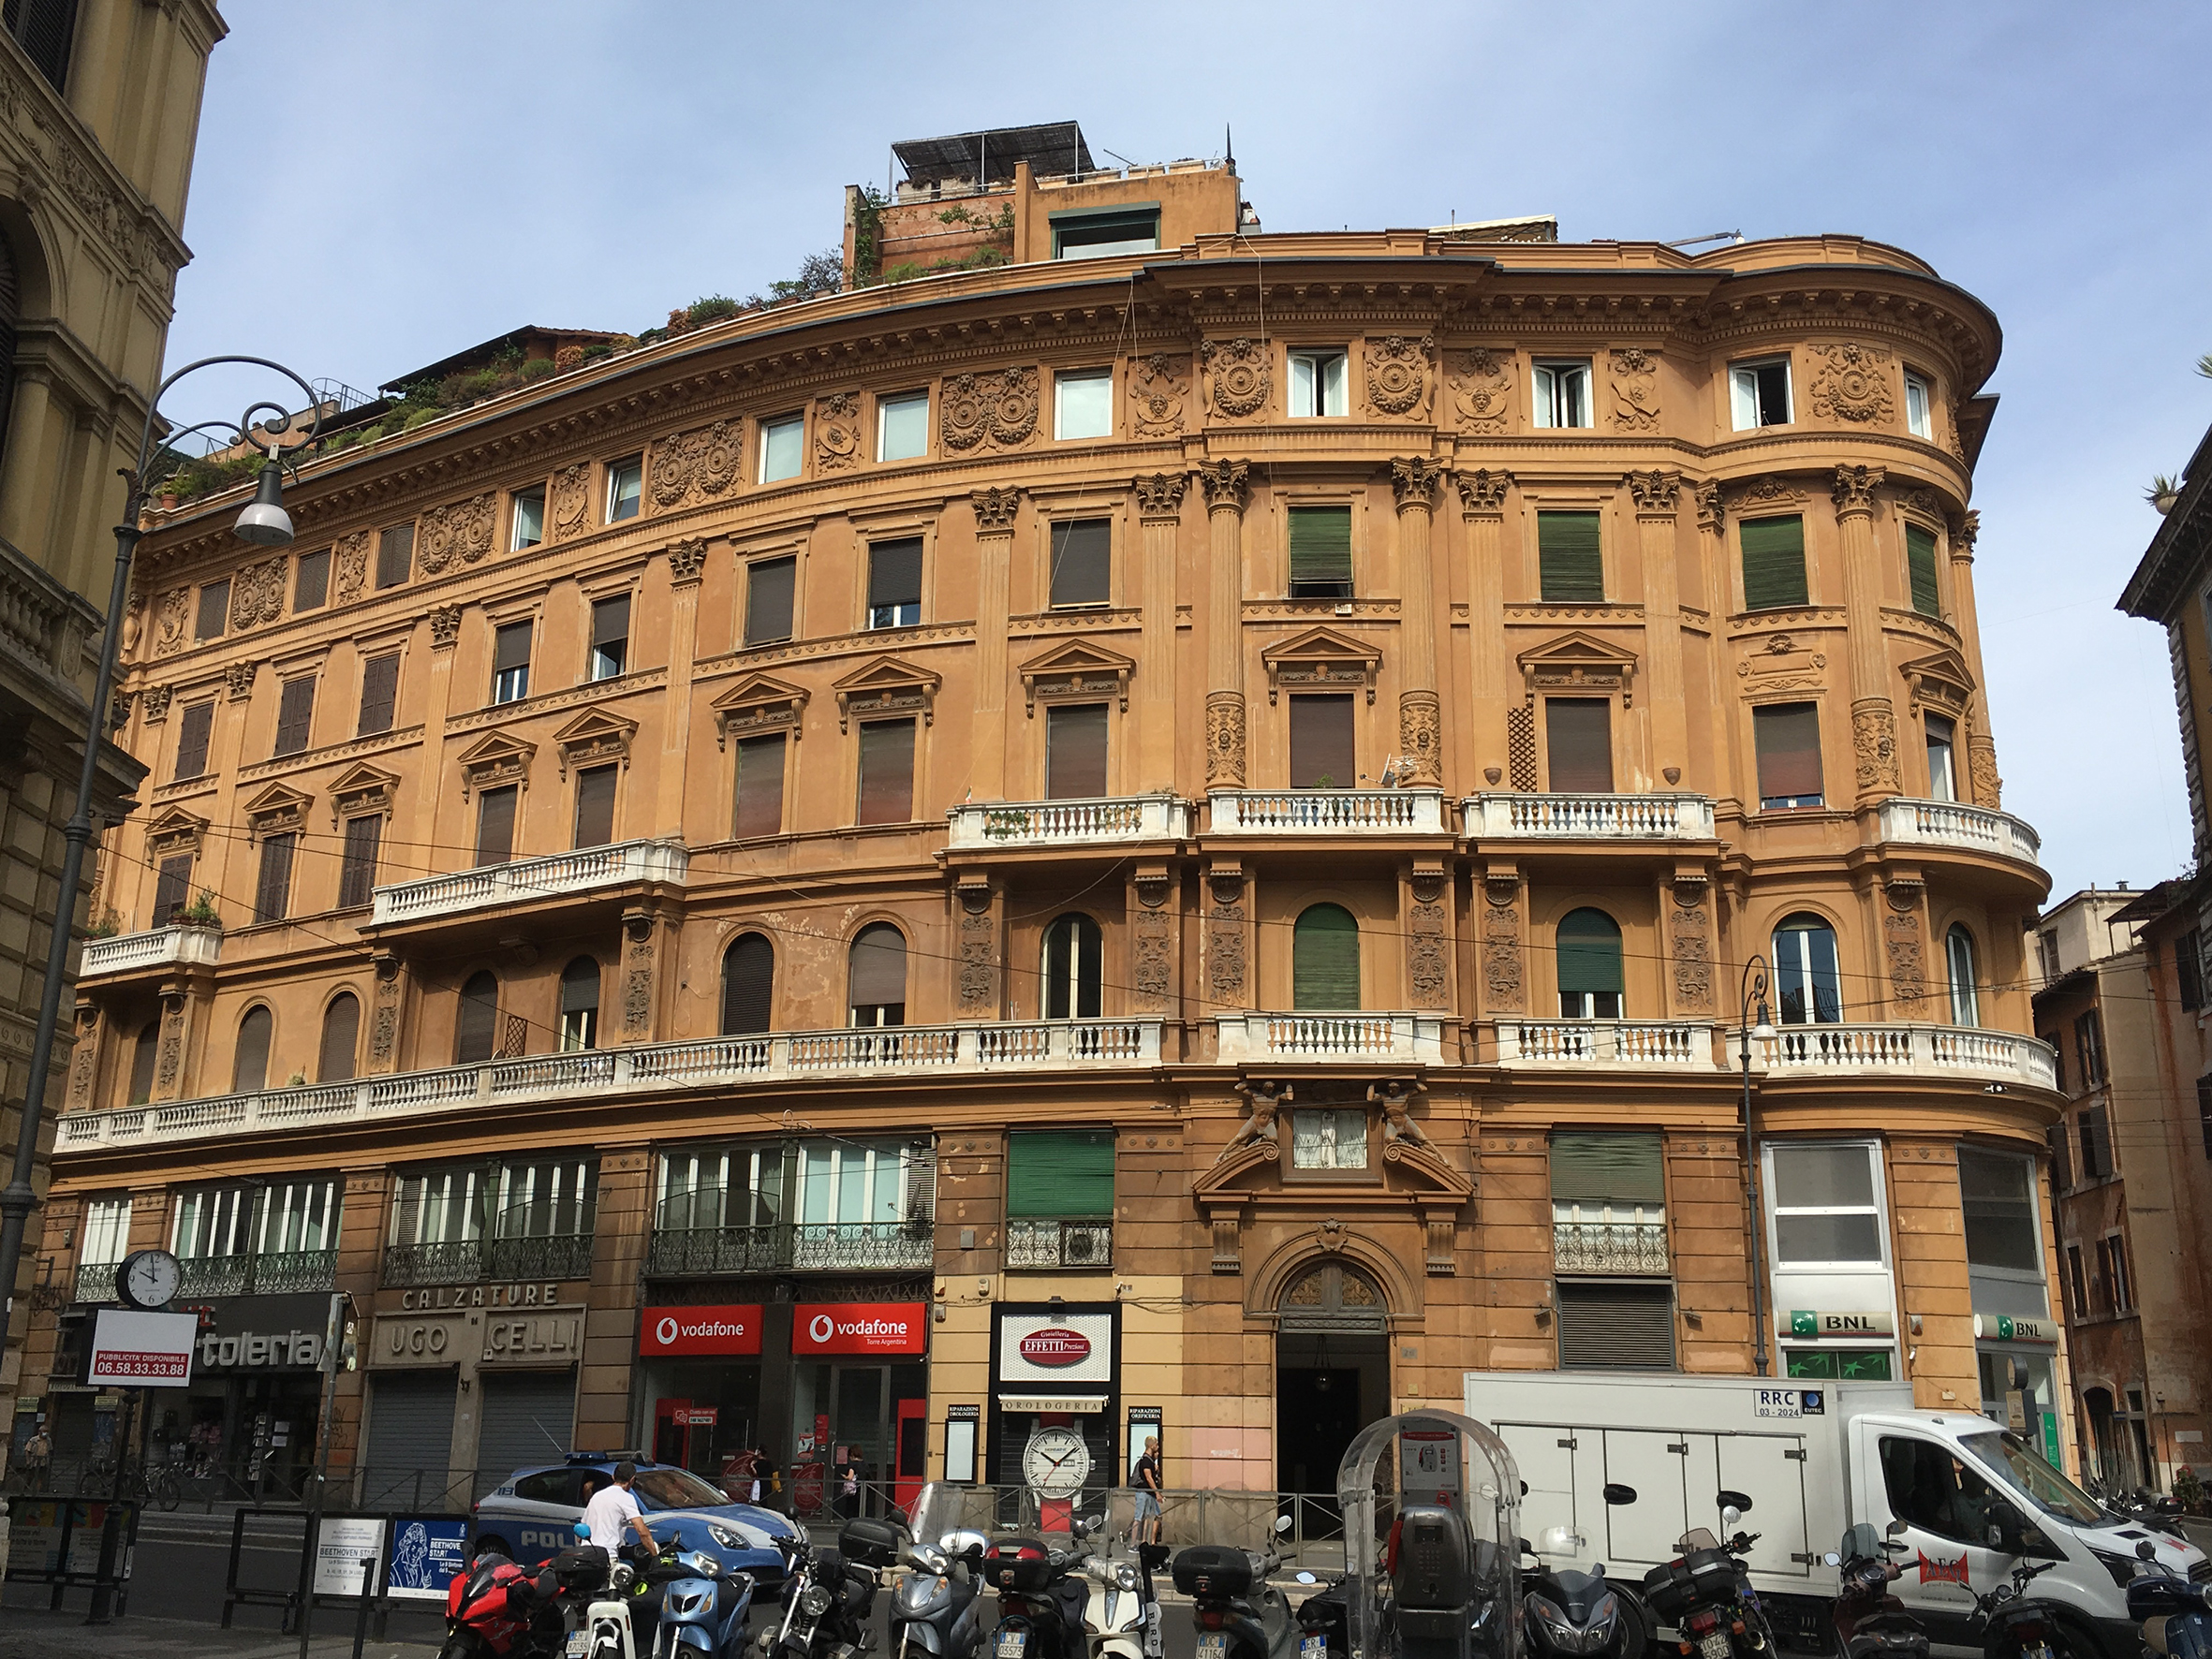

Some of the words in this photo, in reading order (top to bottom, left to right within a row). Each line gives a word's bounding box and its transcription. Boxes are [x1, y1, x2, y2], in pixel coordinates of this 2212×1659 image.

[128, 1274, 135, 1283] 9
[171, 1274, 177, 1283] 3
[148, 1295, 155, 1303] 6
[402, 1284, 558, 1310] CALZATURE
[837, 1319, 907, 1335] vodafone
[1825, 1315, 1876, 1329] BNL
[681, 1321, 745, 1337] vodafone
[2015, 1322, 2042, 1337] BNL
[391, 1325, 449, 1353] UGO
[489, 1319, 579, 1351] CELLI
[196, 1329, 322, 1367] toleria
[880, 1338, 907, 1347] Argentina
[1025, 1340, 1064, 1351] EFFETTI
[142, 1354, 185, 1363] DISPONIBILE
[97, 1362, 184, 1375] 06.58.33.33.88
[1761, 1390, 1794, 1406] RRC
[1006, 1402, 1098, 1410] OROLOGERIA
[1760, 1407, 1770, 1417] 03
[1777, 1408, 1799, 1417] 2024
[497, 1487, 514, 1496] 113
[430, 1541, 462, 1550] BEETHOVE
[319, 1548, 359, 1557] BEETHOVEN
[429, 1549, 449, 1558] START
[1925, 1557, 1962, 1578] AEG
[1147, 1612, 1158, 1647] BIRD
[1306, 1637, 1316, 1650] ER
[998, 1645, 1023, 1657] 03573
